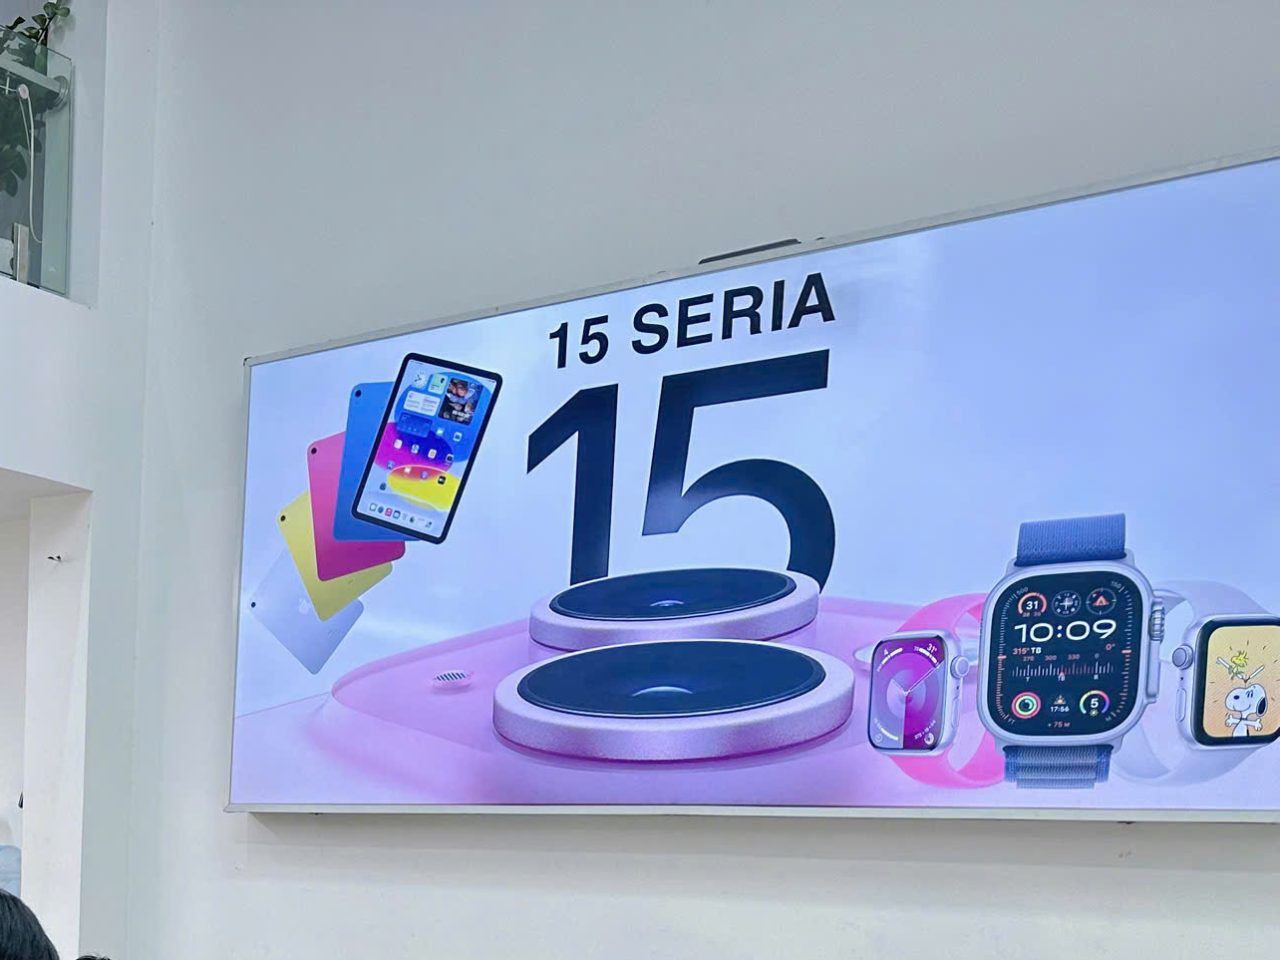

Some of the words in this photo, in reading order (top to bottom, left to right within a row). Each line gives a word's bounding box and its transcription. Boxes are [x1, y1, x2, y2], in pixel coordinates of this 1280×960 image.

[549, 315, 609, 369] 15
[632, 272, 835, 355] SERIA
[527, 349, 836, 595] 15
[1026, 601, 1039, 610] 31
[1014, 619, 1117, 643] 10:09
[1090, 698, 1099, 708] 5
